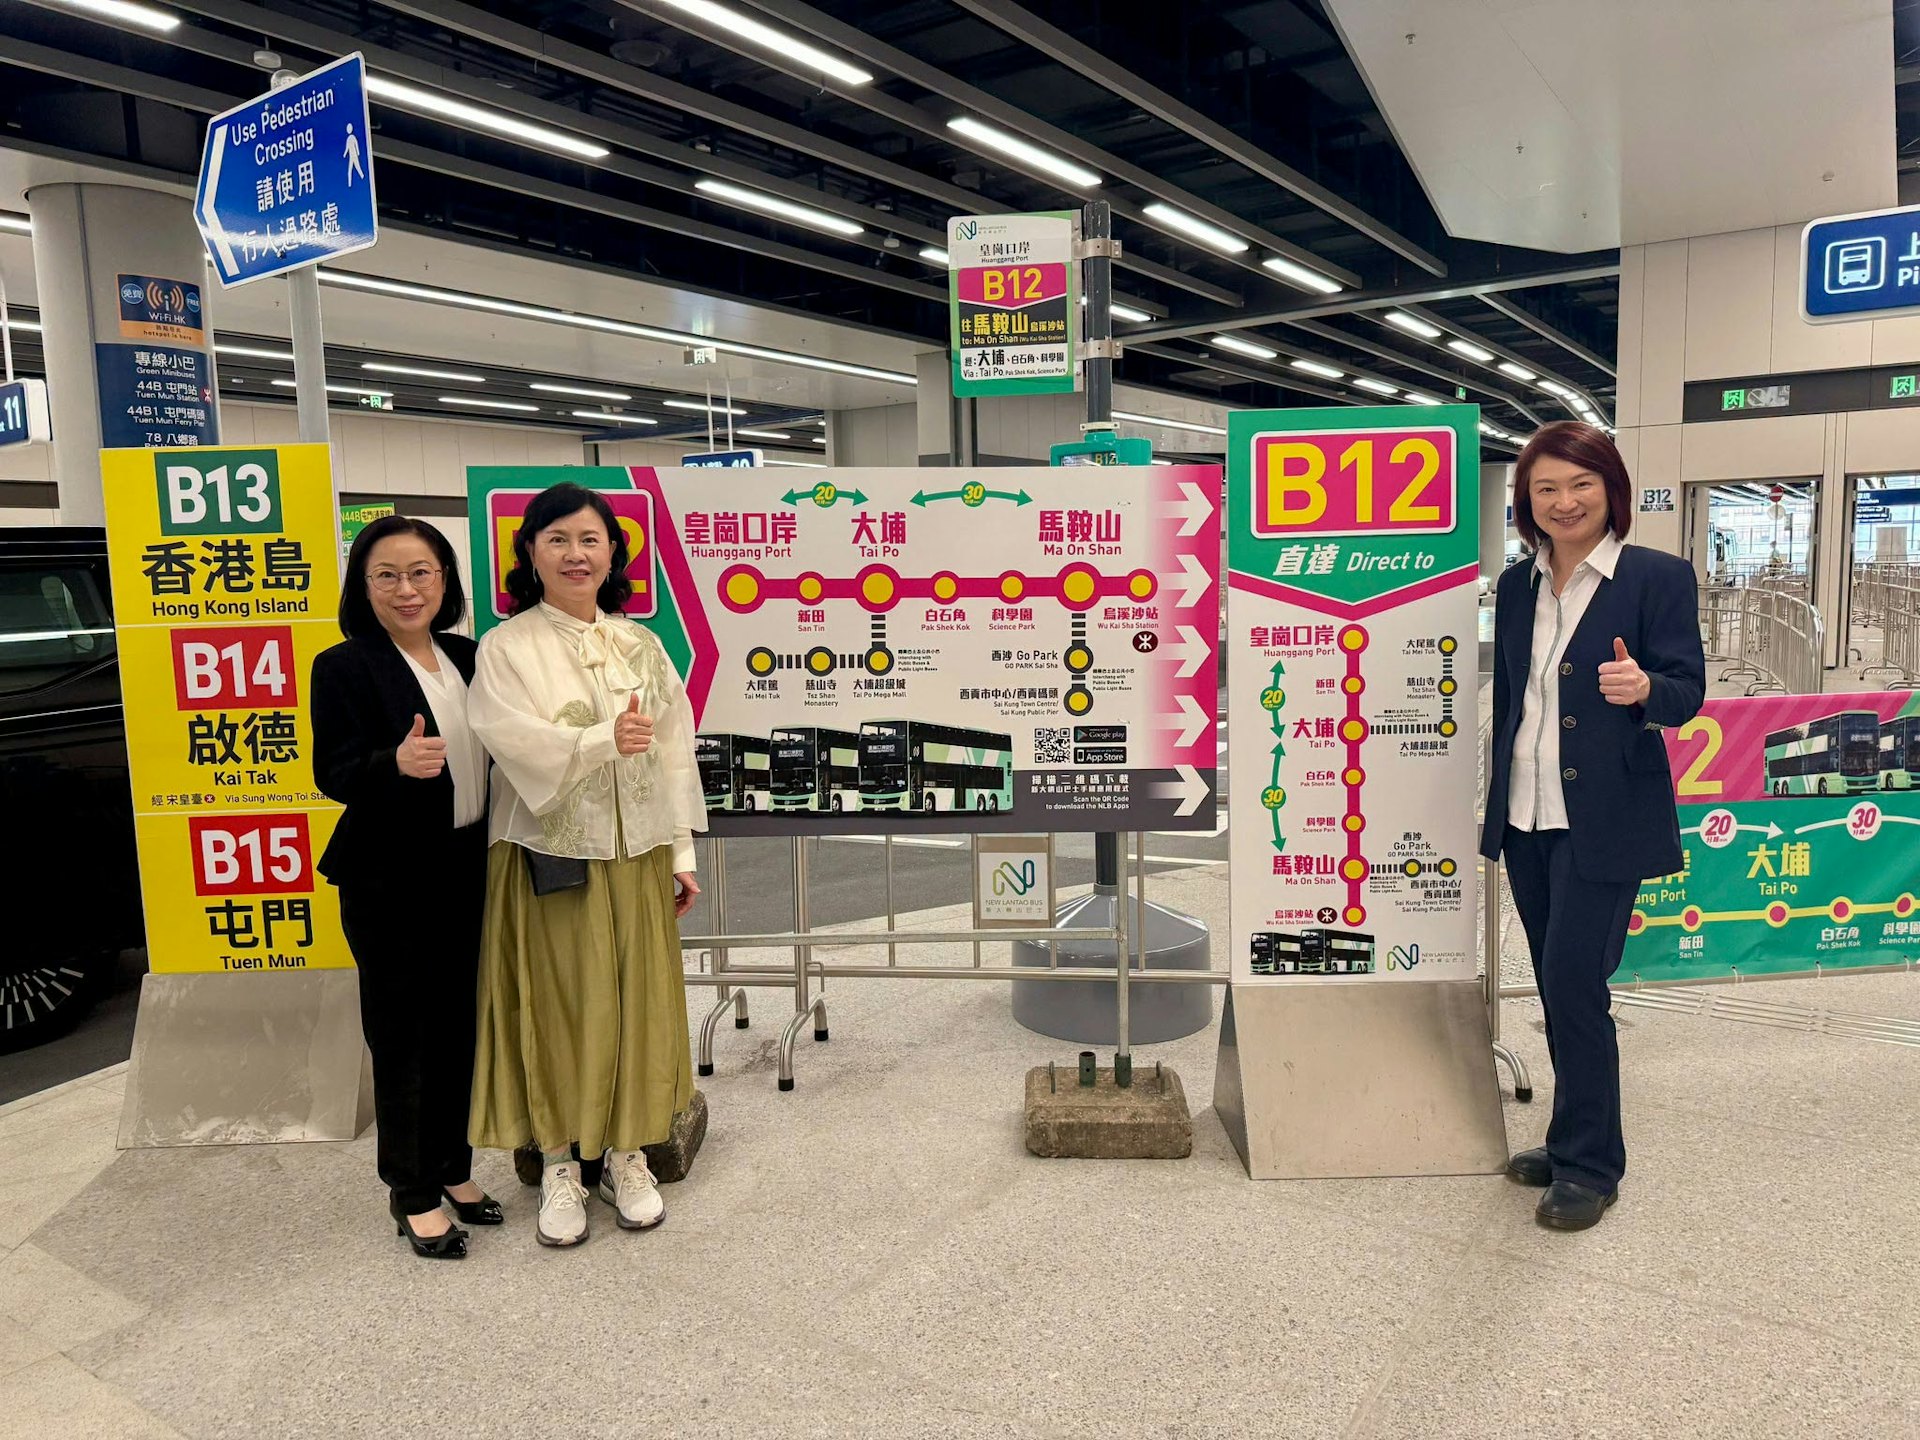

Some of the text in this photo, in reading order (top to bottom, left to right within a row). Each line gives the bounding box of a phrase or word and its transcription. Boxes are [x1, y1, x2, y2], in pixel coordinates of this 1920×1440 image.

[232, 88, 334, 146] Use Pedestrian
[255, 128, 314, 165] Crossing
[257, 160, 314, 212] 請使用
[242, 202, 340, 264] 行人過路處
[980, 241, 1030, 256] 皇崗口岸
[981, 256, 1015, 264] Huanggang
[983, 268, 1042, 301] B12
[974, 336, 985, 344] Ma
[987, 336, 997, 344] On
[1000, 335, 1018, 343] Shan
[134, 351, 195, 371] 專線小巴
[162, 368, 195, 379] Minibuses
[963, 370, 974, 378] Via
[980, 368, 991, 377] Tai
[137, 381, 197, 396] 44B 屯門站
[158, 392, 175, 400] Mun
[176, 394, 200, 402] Station
[127, 406, 205, 421] 44B1 屯門碼頭
[133, 416, 154, 424] Tuen
[155, 417, 173, 425] Mun
[175, 419, 192, 427] Ferry
[146, 433, 162, 442] 78
[1267, 438, 1440, 526] B12
[166, 463, 272, 524] B13
[815, 486, 835, 500] 20
[965, 485, 984, 500] 30
[1644, 489, 1671, 503] B12
[685, 511, 797, 544] 皇崗口岸
[851, 511, 906, 544] 大埔
[1039, 509, 1121, 542] 馬鞍山
[691, 546, 791, 560] Huanggang Port
[859, 546, 899, 558] Tai Po
[1044, 543, 1122, 556] Ma On Shan
[142, 538, 312, 596] 香港島
[1272, 544, 1435, 576] 直達 Direct to
[152, 596, 309, 619] Hong Kong Island
[925, 608, 966, 622] 白石角
[992, 608, 1033, 622] 科學園
[797, 609, 824, 623] 新田
[798, 624, 825, 632] San Tin
[988, 623, 1016, 631] Science
[1250, 625, 1334, 647] 皇崗口岸
[991, 650, 1058, 661] 西沙 Go Park
[1264, 649, 1313, 658] Huanggang
[182, 640, 286, 699] B14
[805, 679, 837, 691] 慈山寺
[804, 700, 839, 708] Monastery
[1263, 690, 1283, 704] 20
[1293, 717, 1334, 738] 大埔
[188, 711, 299, 766] 啟德
[1324, 740, 1335, 748] Po
[1086, 754, 1103, 762] App
[214, 769, 277, 786] Kai Tak
[225, 794, 240, 803] Via
[242, 793, 265, 803] Sung
[267, 793, 293, 803] Wong
[295, 792, 308, 801] Toi
[1264, 789, 1284, 803] 30
[1852, 807, 1877, 828] 30
[1705, 815, 1732, 836] 20
[1394, 842, 1431, 850] Go Park
[200, 827, 302, 885] B15
[1746, 842, 1811, 878] 大埔
[1272, 854, 1335, 875] 馬鞍山
[1660, 889, 1686, 902] Port
[1759, 882, 1798, 895] Tai Po
[205, 899, 313, 949] 屯門
[1822, 926, 1859, 941] 白石角
[1679, 935, 1704, 950] 新田
[1831, 941, 1846, 949] Shek
[220, 954, 306, 970] Tuen Mun
